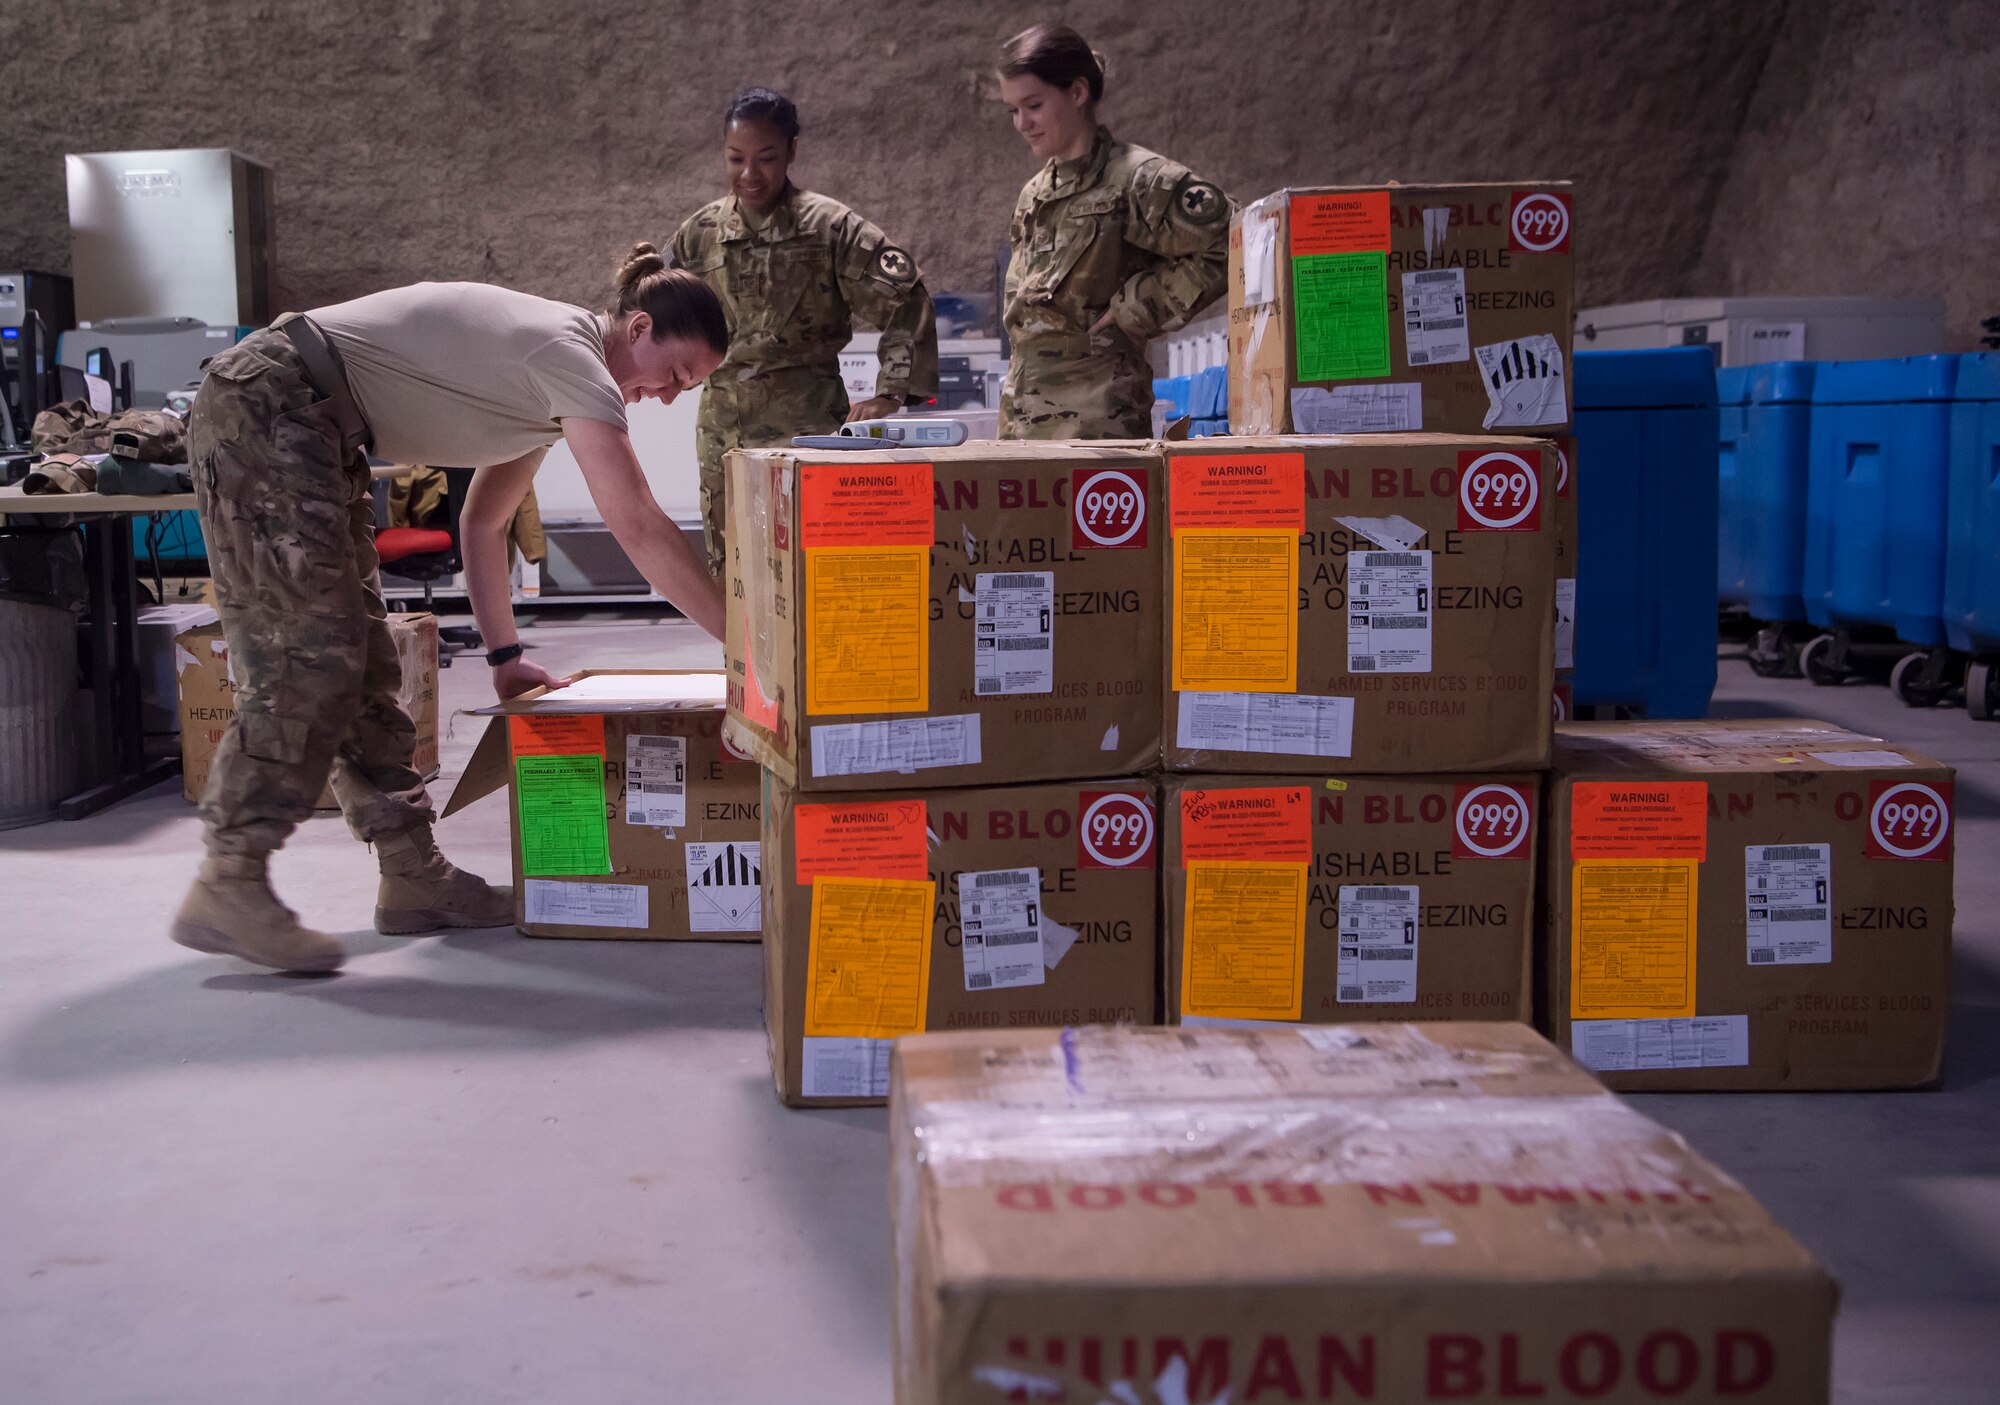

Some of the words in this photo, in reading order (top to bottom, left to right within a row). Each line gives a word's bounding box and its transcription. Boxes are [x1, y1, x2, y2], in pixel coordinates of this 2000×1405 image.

[1317, 202, 1362, 212] WARNING!
[1447, 202, 1504, 228] BLO
[1521, 208, 1561, 236] 999
[1388, 248, 1512, 271] RISHABLE
[1464, 290, 1557, 311] REEZING
[1207, 465, 1267, 476] WARNING!
[839, 476, 897, 487] WARNING!
[1371, 467, 1458, 498] BLO
[1472, 472, 1527, 507] 999
[999, 477, 1069, 510] BLO
[1086, 491, 1135, 525] 999
[1324, 586, 1346, 611] O
[1432, 585, 1523, 610] EZING
[1351, 603, 1367, 611] DOV
[1351, 618, 1365, 626] IUD
[1096, 679, 1143, 697] BLOOD
[1327, 676, 1383, 692] ARMED
[1392, 676, 1467, 692] SERVICES
[1014, 706, 1088, 724] PROGRAM
[1386, 700, 1466, 716] PROGRAM
[1218, 798, 1275, 810] WARNING!
[1610, 792, 1669, 803] WARNING!
[831, 812, 889, 824] WARNING!
[1363, 793, 1447, 824] BLO
[988, 808, 1072, 840] BLO
[1092, 813, 1144, 846] 999
[1467, 803, 1519, 836] 999
[1883, 802, 1938, 837] 999
[1312, 851, 1453, 878] ISHABLE
[731, 909, 738, 917] 9
[1840, 906, 1928, 930] EZING
[1461, 991, 1511, 1008] BLOOD
[1793, 995, 1870, 1012] SERVICES
[1879, 995, 1932, 1012] BLOOD
[947, 1010, 1000, 1027] ARMED
[1008, 1008, 1080, 1025] SERVICES
[1788, 1020, 1869, 1035] PROGRAM
[1424, 1326, 1778, 1401] BLOOD
